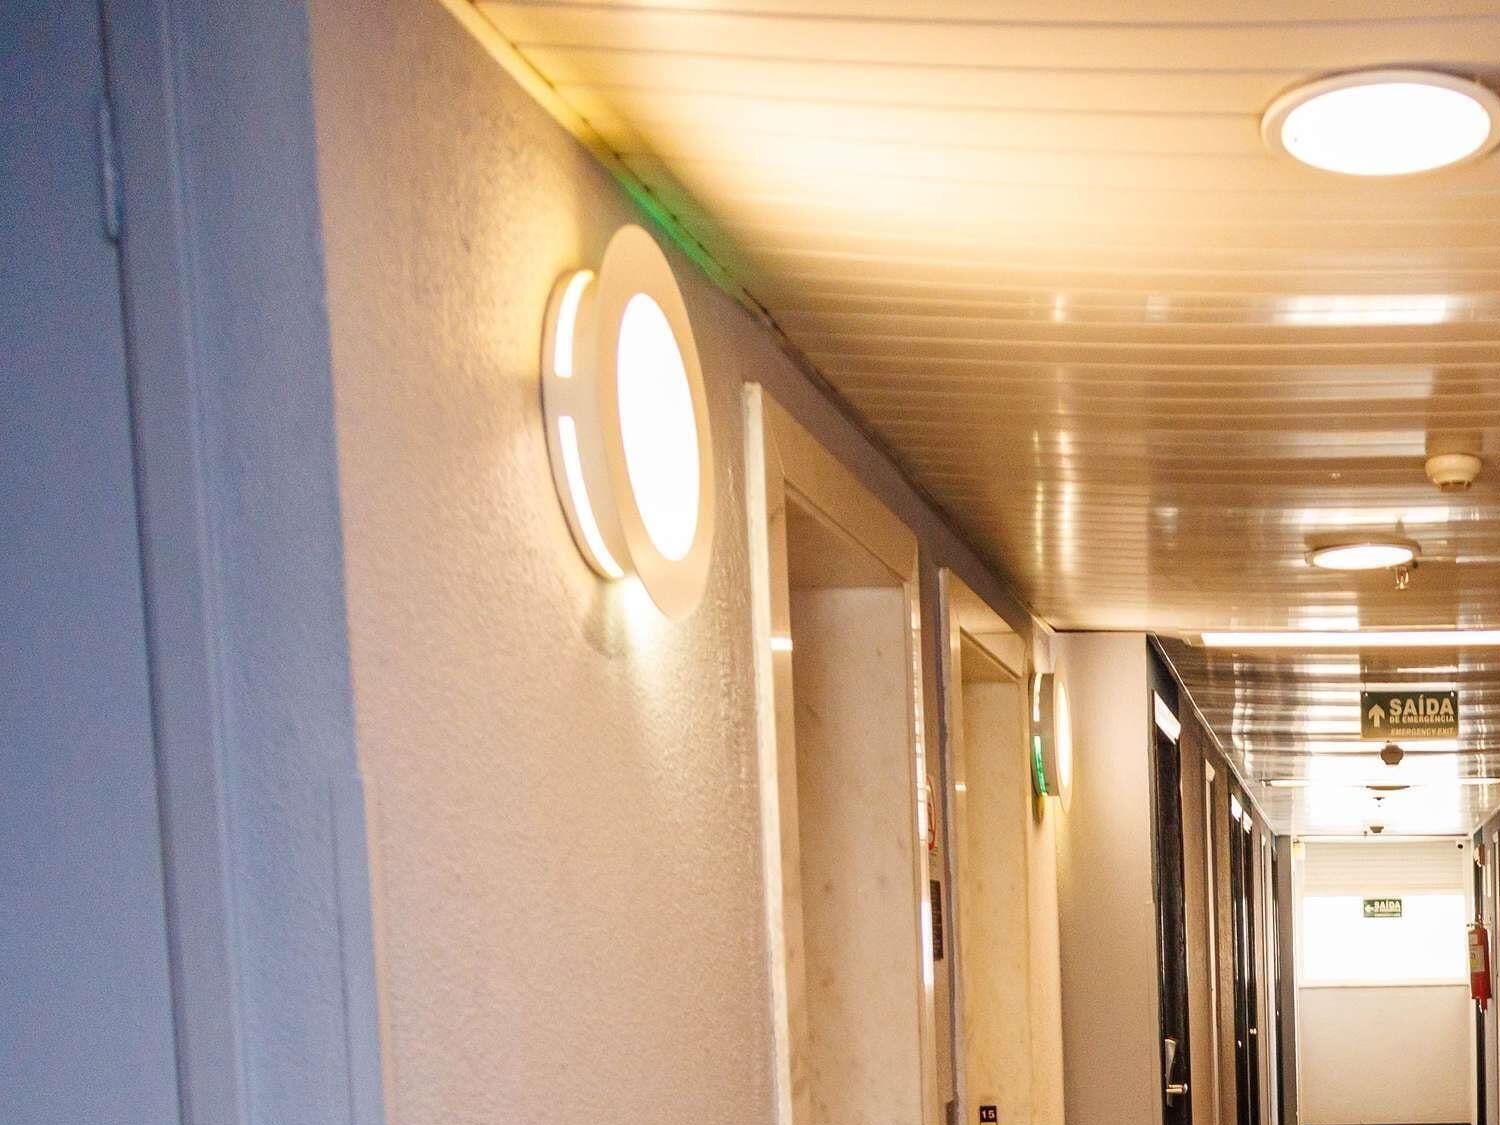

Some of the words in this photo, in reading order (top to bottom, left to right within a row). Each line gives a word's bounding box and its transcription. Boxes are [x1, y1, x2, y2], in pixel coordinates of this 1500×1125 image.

[1389, 693, 1454, 715] SAÍDA
[1389, 715, 1400, 724] DE
[981, 1110, 995, 1119] 15
